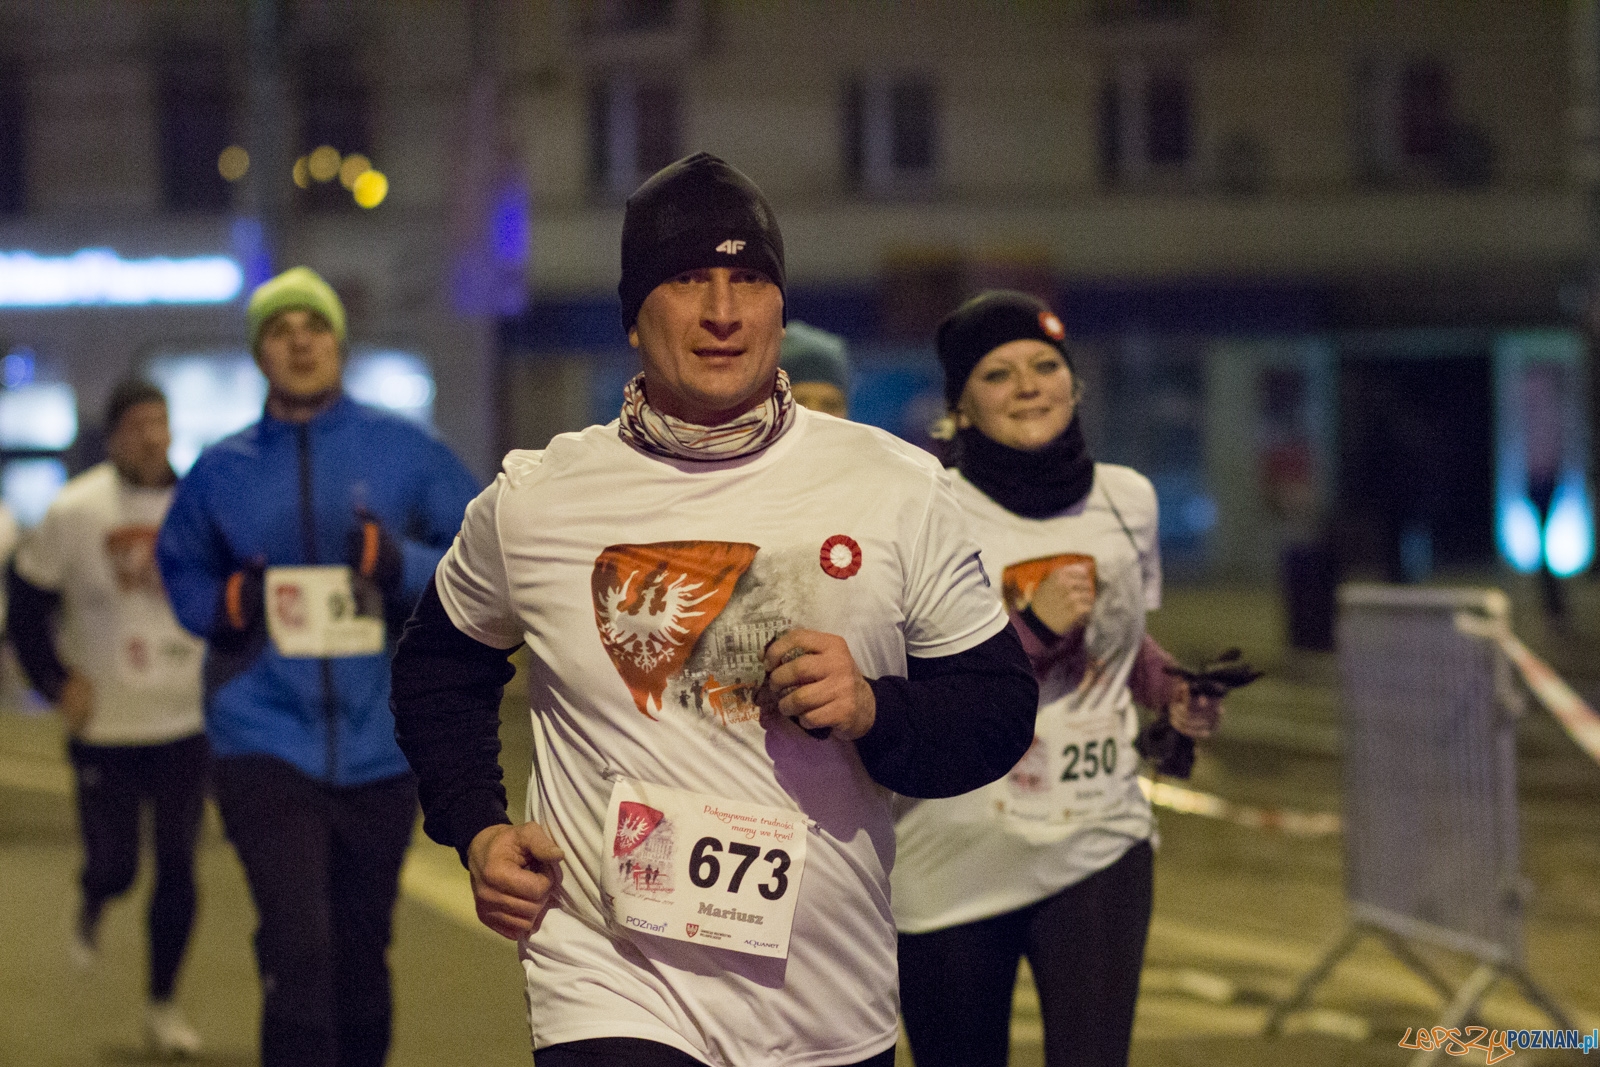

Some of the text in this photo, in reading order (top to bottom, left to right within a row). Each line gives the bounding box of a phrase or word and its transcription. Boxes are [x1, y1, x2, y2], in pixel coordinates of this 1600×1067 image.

[715, 239, 746, 255] 4F
[1060, 737, 1118, 782] 250
[731, 825, 757, 839] mamy
[773, 829, 794, 843] krwi!
[688, 836, 791, 900] 673
[697, 901, 764, 926] Mariusz
